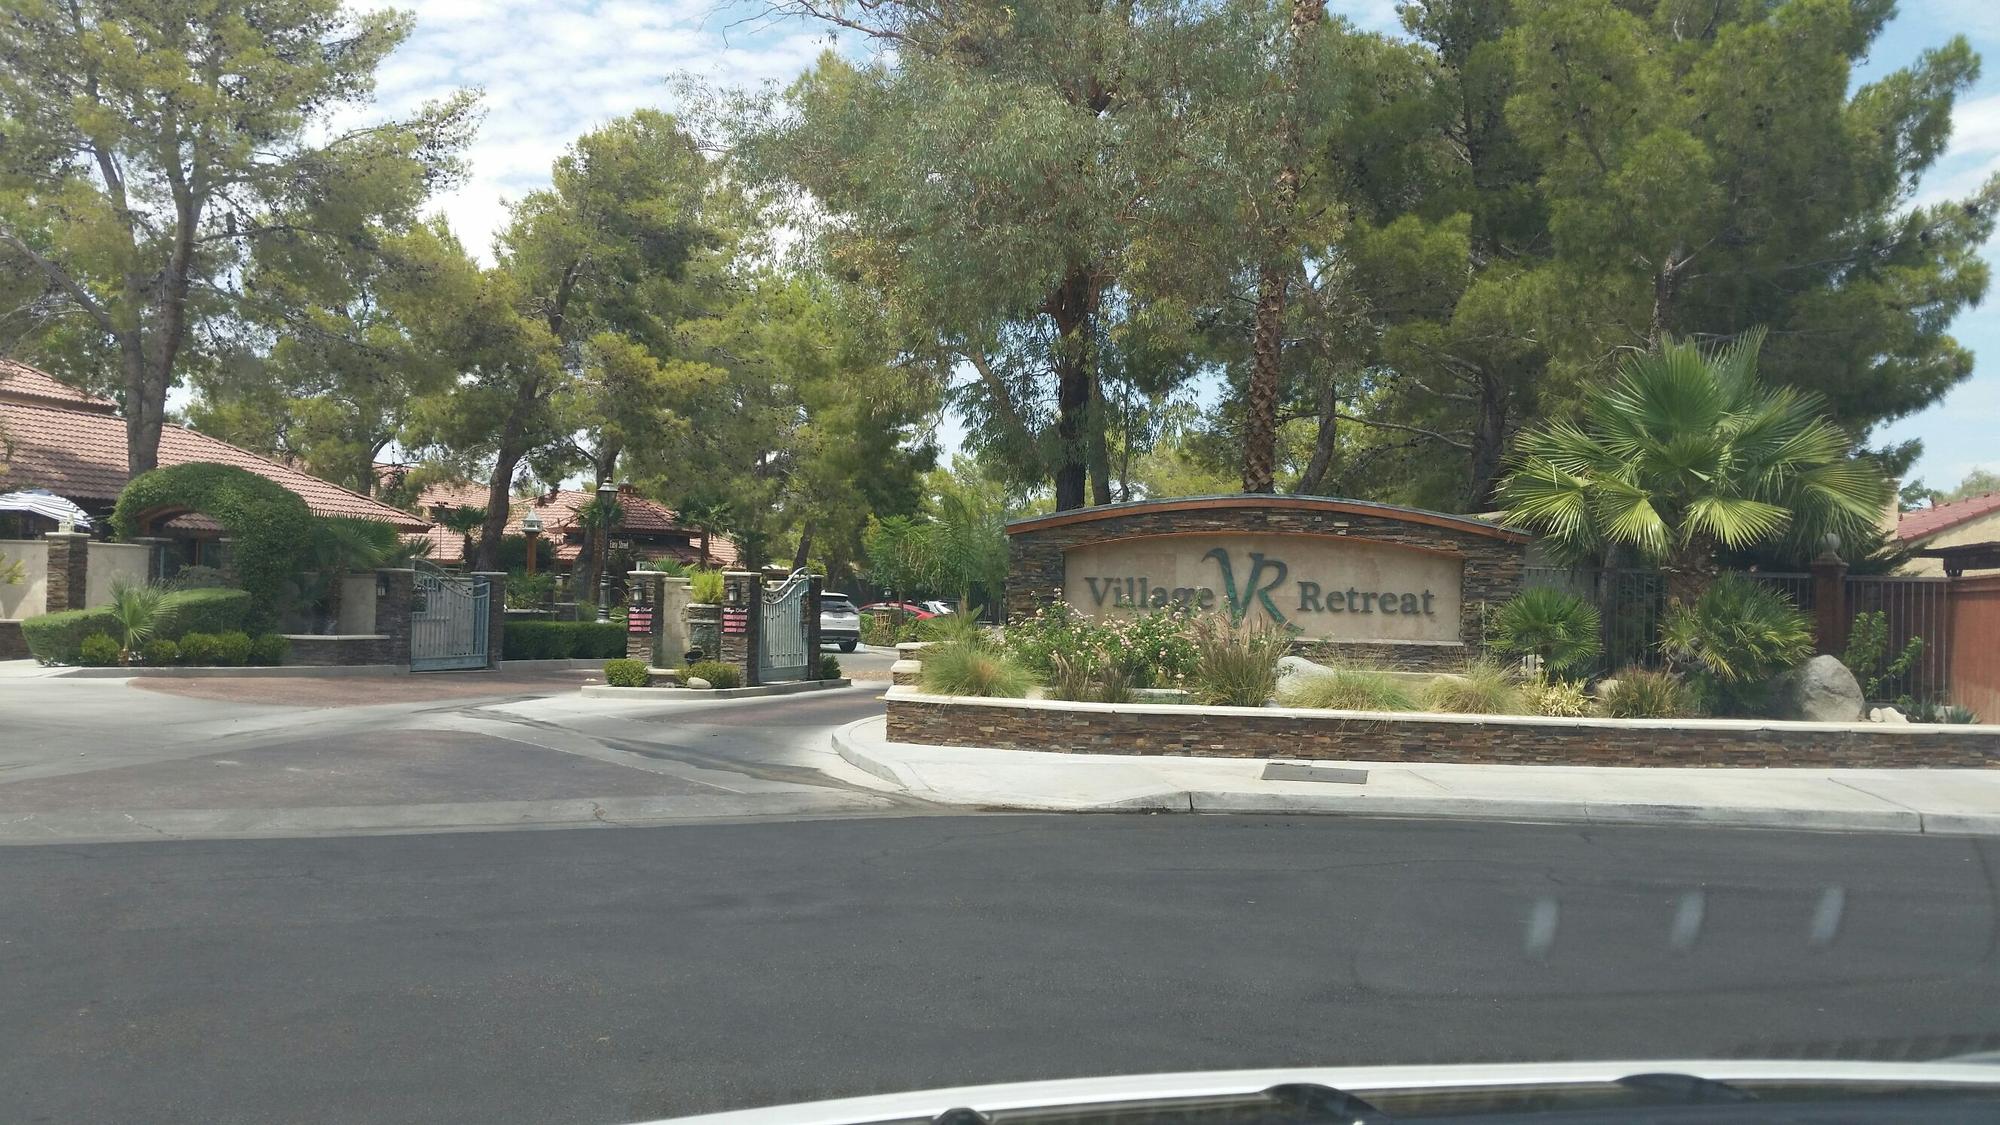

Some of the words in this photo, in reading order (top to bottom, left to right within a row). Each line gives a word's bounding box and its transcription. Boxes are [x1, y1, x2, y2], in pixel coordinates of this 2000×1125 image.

[1083, 576, 1215, 619] Village
[1200, 547, 1305, 630] VR
[1296, 581, 1435, 615] Retreat
